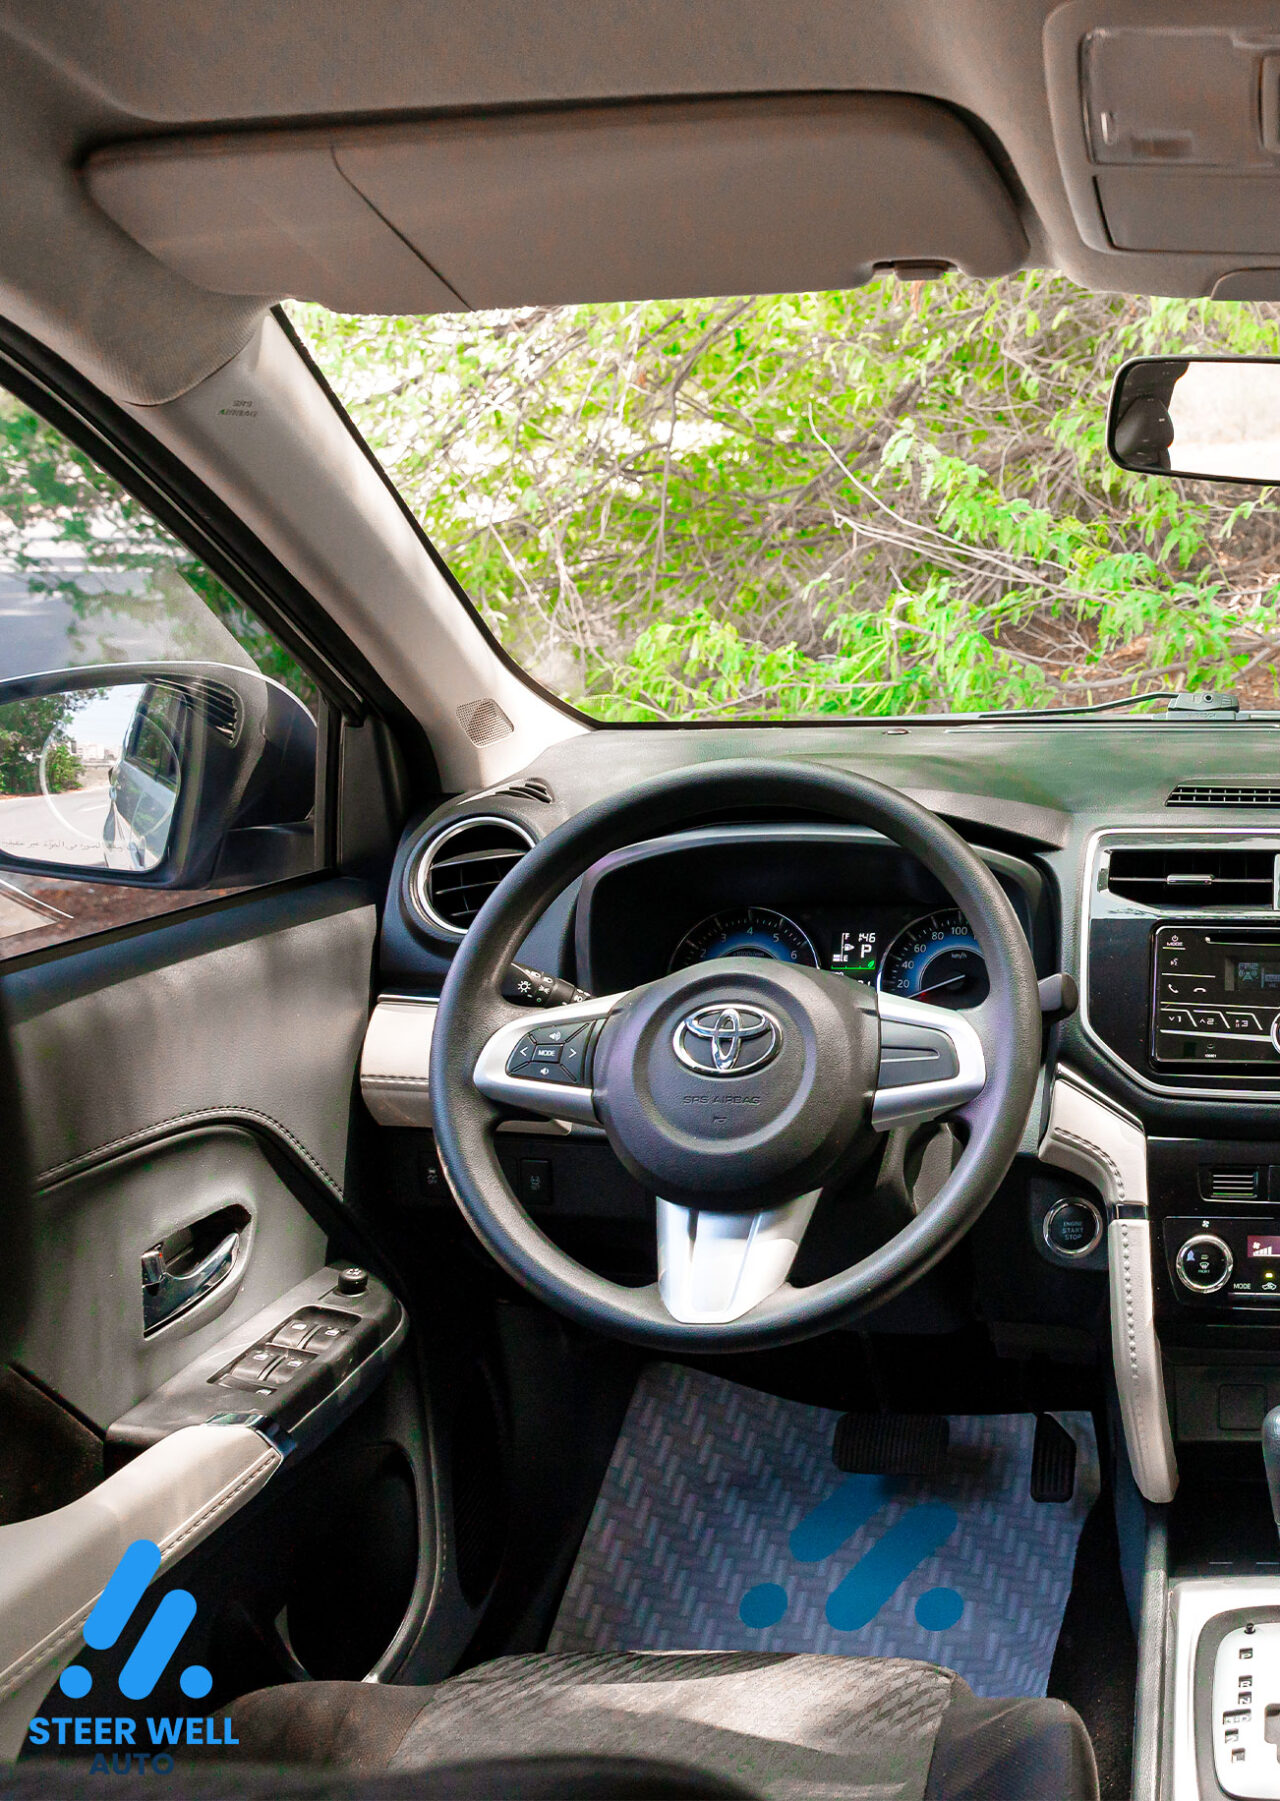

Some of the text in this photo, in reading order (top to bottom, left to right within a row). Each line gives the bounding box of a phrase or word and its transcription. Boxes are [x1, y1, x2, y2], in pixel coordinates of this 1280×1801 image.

[746, 926, 753, 935] 4
[951, 926, 968, 935] 100
[721, 933, 727, 942] 3
[773, 933, 780, 943] 5
[931, 931, 945, 941] 80
[860, 944, 872, 958] P
[913, 944, 927, 953] 60
[790, 950, 798, 959] 6
[901, 960, 915, 969] 40
[897, 979, 910, 988] 20
[538, 1049, 556, 1057] MODE
[683, 1095, 761, 1106] SRS AIRBAG
